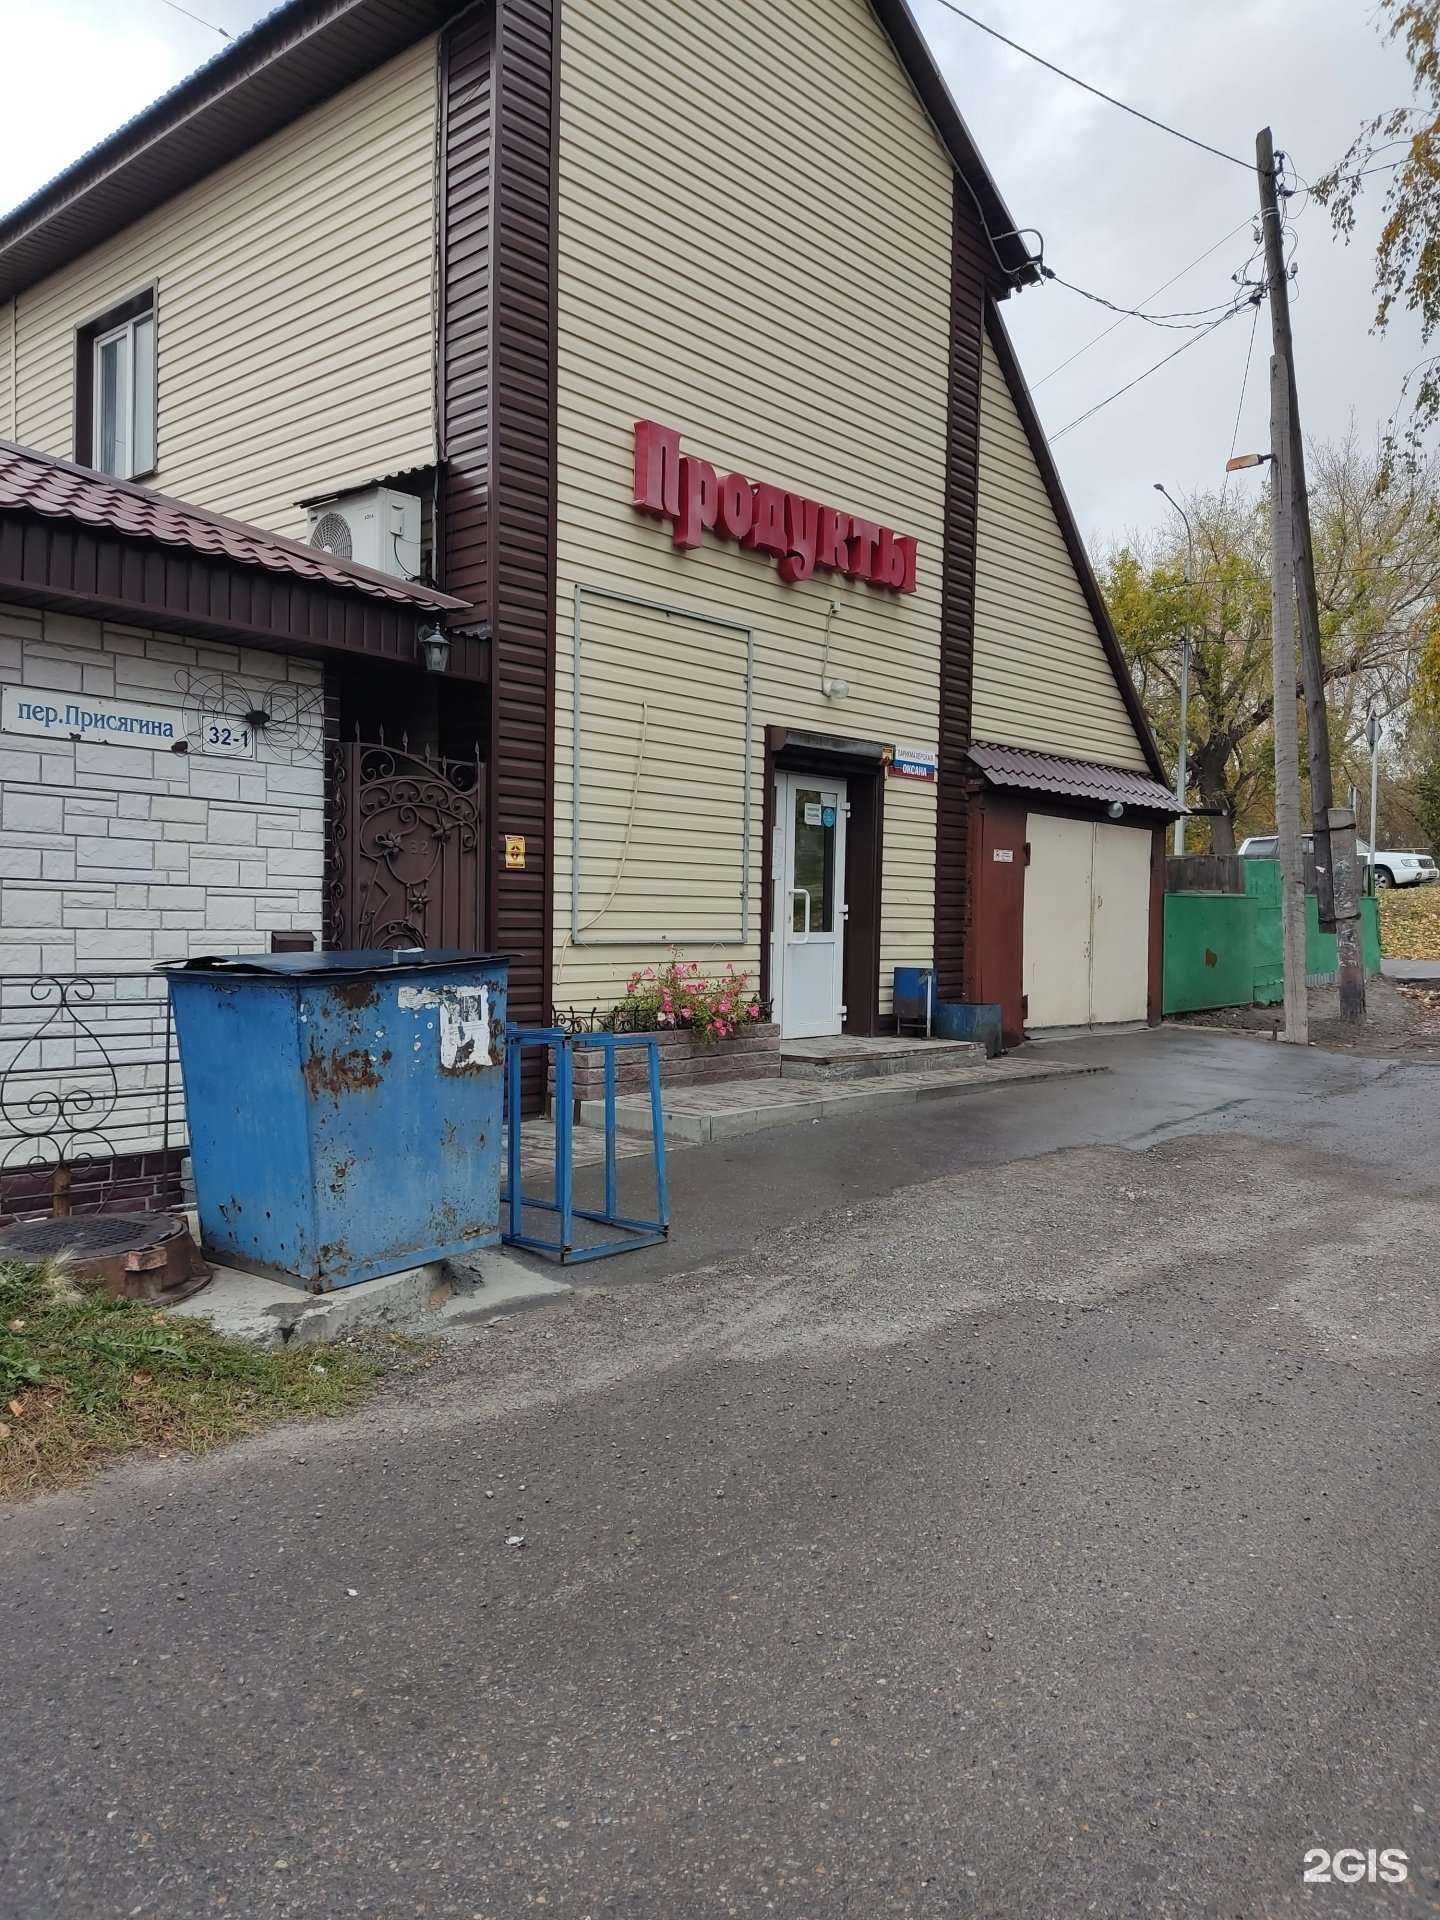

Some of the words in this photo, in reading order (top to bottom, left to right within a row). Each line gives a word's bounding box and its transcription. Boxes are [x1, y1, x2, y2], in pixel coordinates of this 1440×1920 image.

[633, 419, 918, 594] Продукты
[18, 702, 174, 738] пер.Присягина
[208, 726, 249, 748] 32-1
